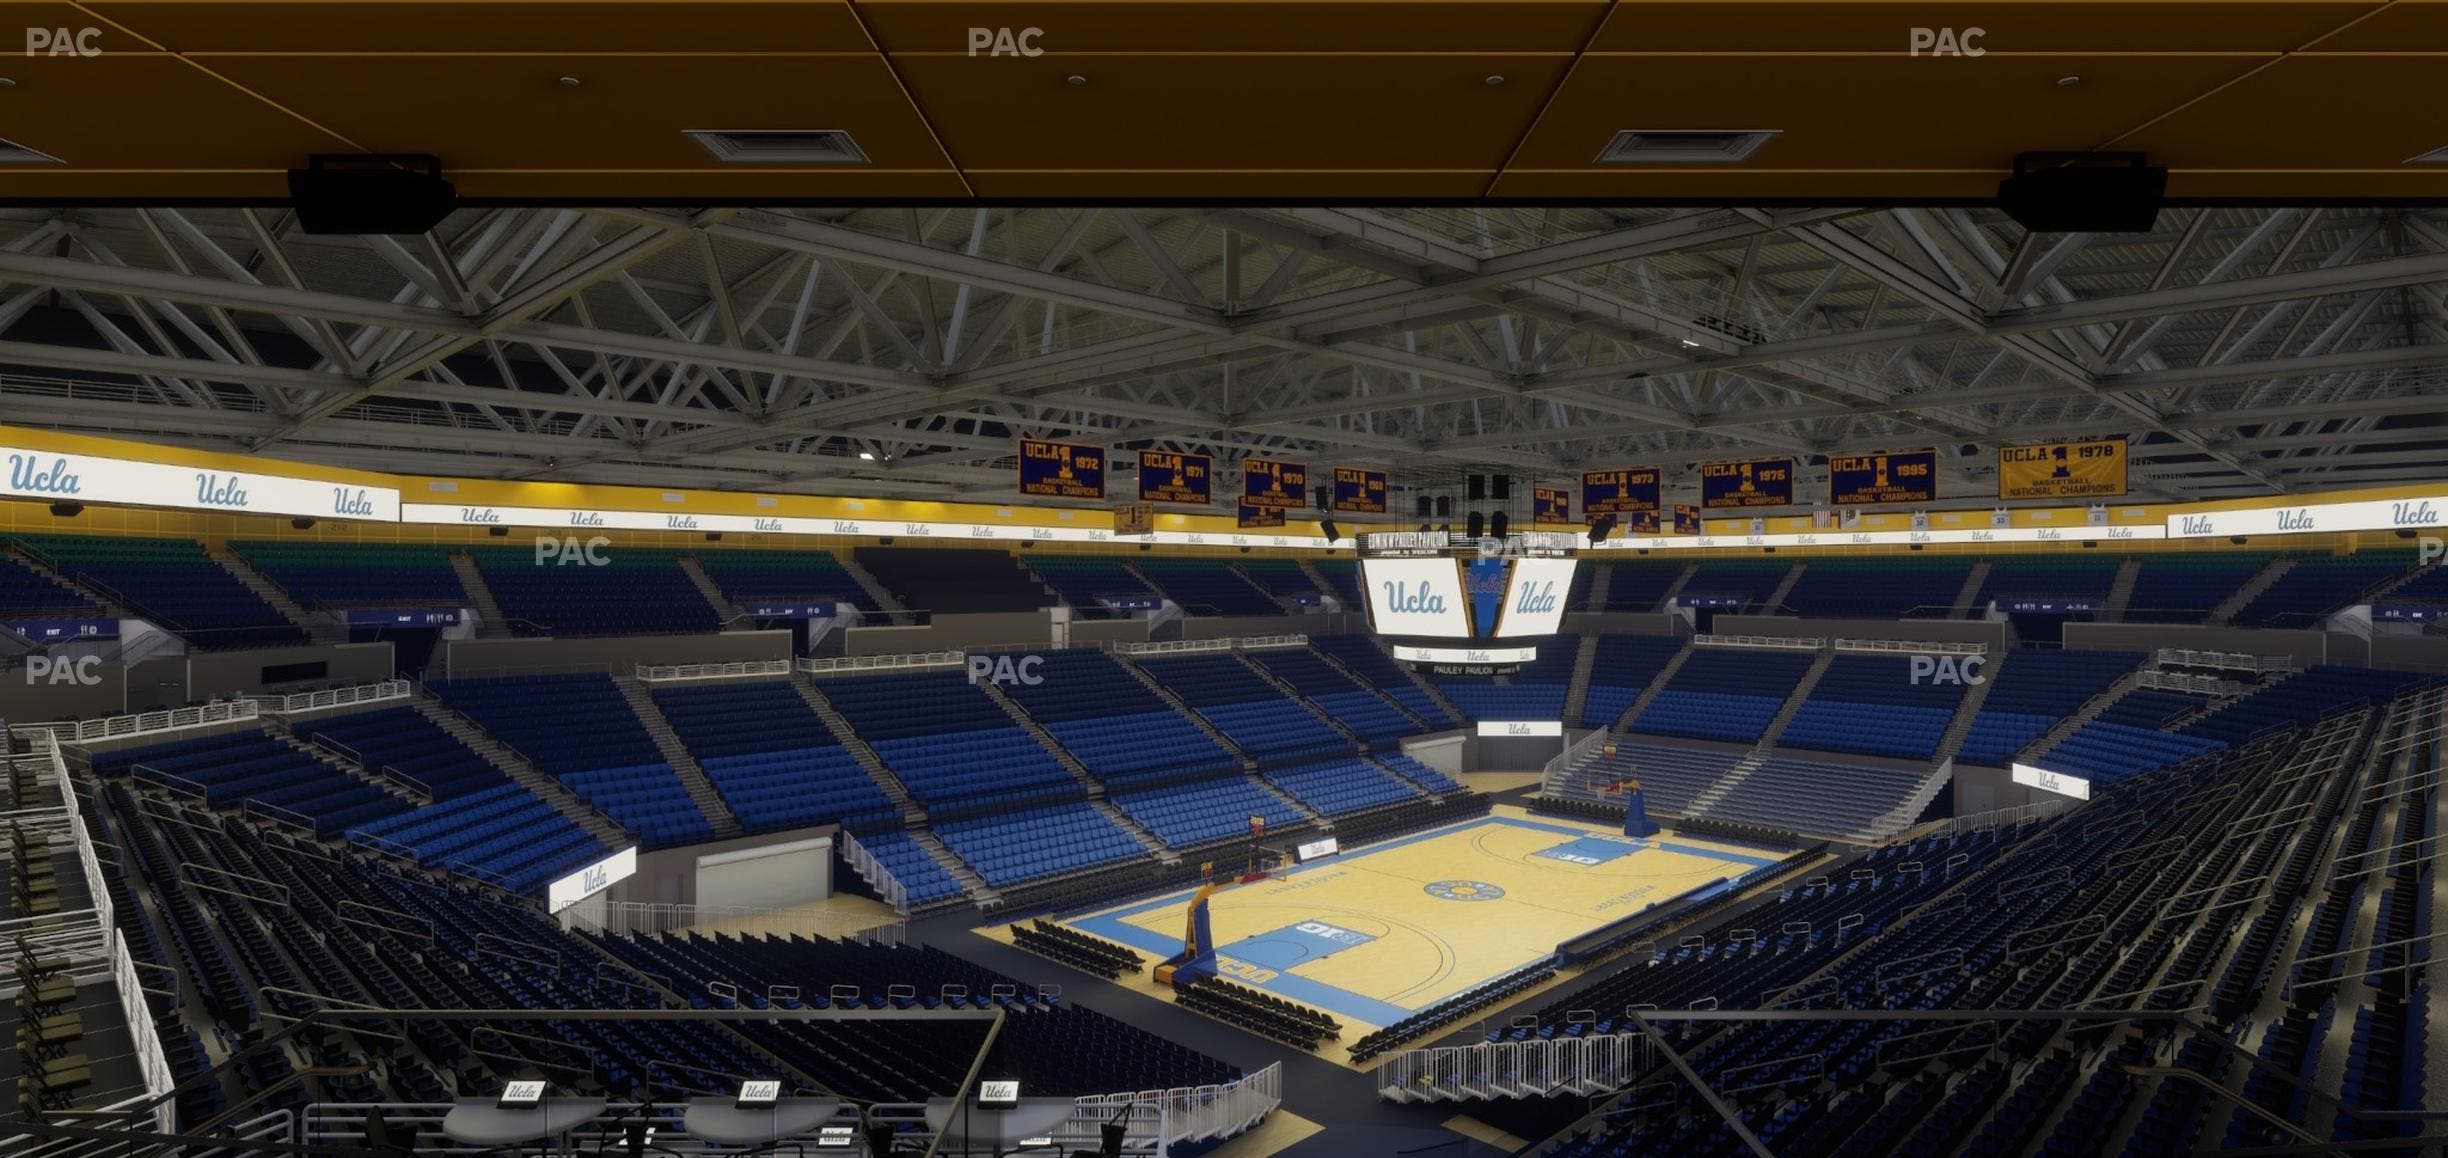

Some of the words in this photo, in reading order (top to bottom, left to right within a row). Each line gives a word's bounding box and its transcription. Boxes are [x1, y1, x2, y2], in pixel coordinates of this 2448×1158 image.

[1025, 443, 1059, 459] UCLA
[1076, 456, 1098, 470] 1972
[2002, 447, 2048, 462] UCLA
[2079, 445, 2114, 459] 1978
[1144, 453, 1172, 469] UCLA
[1186, 466, 1204, 478] 1971
[1703, 465, 1737, 477] UCLA
[1833, 458, 1871, 473] UCLA
[1896, 463, 1928, 476] 1995
[9, 454, 81, 494] Ucla
[1246, 461, 1269, 474] UCLA
[1283, 472, 1303, 485] 1970
[1337, 470, 1358, 483] UCLA
[1587, 472, 1616, 485] UCLA
[2032, 478, 2089, 486] BASKETBALL
[196, 473, 248, 507] Ucla
[1026, 483, 1057, 494] NATIONAL
[1063, 486, 1098, 496] CHAMPIONS
[2009, 486, 2052, 497] NATIONAL
[2060, 484, 2115, 495] CHAMPIONS
[333, 487, 373, 517] Ucla
[1708, 498, 1740, 507] NATIONAL
[1745, 496, 1785, 506] CHAMPIONS
[1838, 494, 1875, 504] NATIONAL
[1881, 492, 1928, 502] CHAMPIONS
[461, 508, 500, 524] Ucla
[570, 511, 604, 526] Ucla
[2277, 509, 2314, 531] Ucla
[2392, 501, 2439, 525] Ucla
[666, 515, 698, 529] Ucla
[754, 518, 782, 532] Ucla
[834, 521, 859, 534] Ucla
[2182, 515, 2213, 535] Ucla
[905, 523, 929, 536] Ucla
[972, 526, 993, 538] Ucla
[1910, 531, 1930, 542] Ucla
[1972, 530, 1994, 541] Ucla
[2037, 529, 2061, 539] Ucla
[2107, 528, 2132, 538] Ucla
[1852, 533, 1871, 543] Ucla
[1384, 580, 1447, 614] Ucla
[1516, 580, 1557, 614] Ucla
[1466, 651, 1491, 661] Ucla
[1434, 665, 1462, 675] PAULEY
[1465, 665, 1493, 675] PAVILION
[1508, 724, 1531, 735] Ucla
[2039, 772, 2060, 790] Ucla
[583, 865, 608, 894] Ucla
[508, 1084, 536, 1098] Ucla
[745, 1084, 772, 1098] Ucla
[985, 1084, 1012, 1098] Ucla
